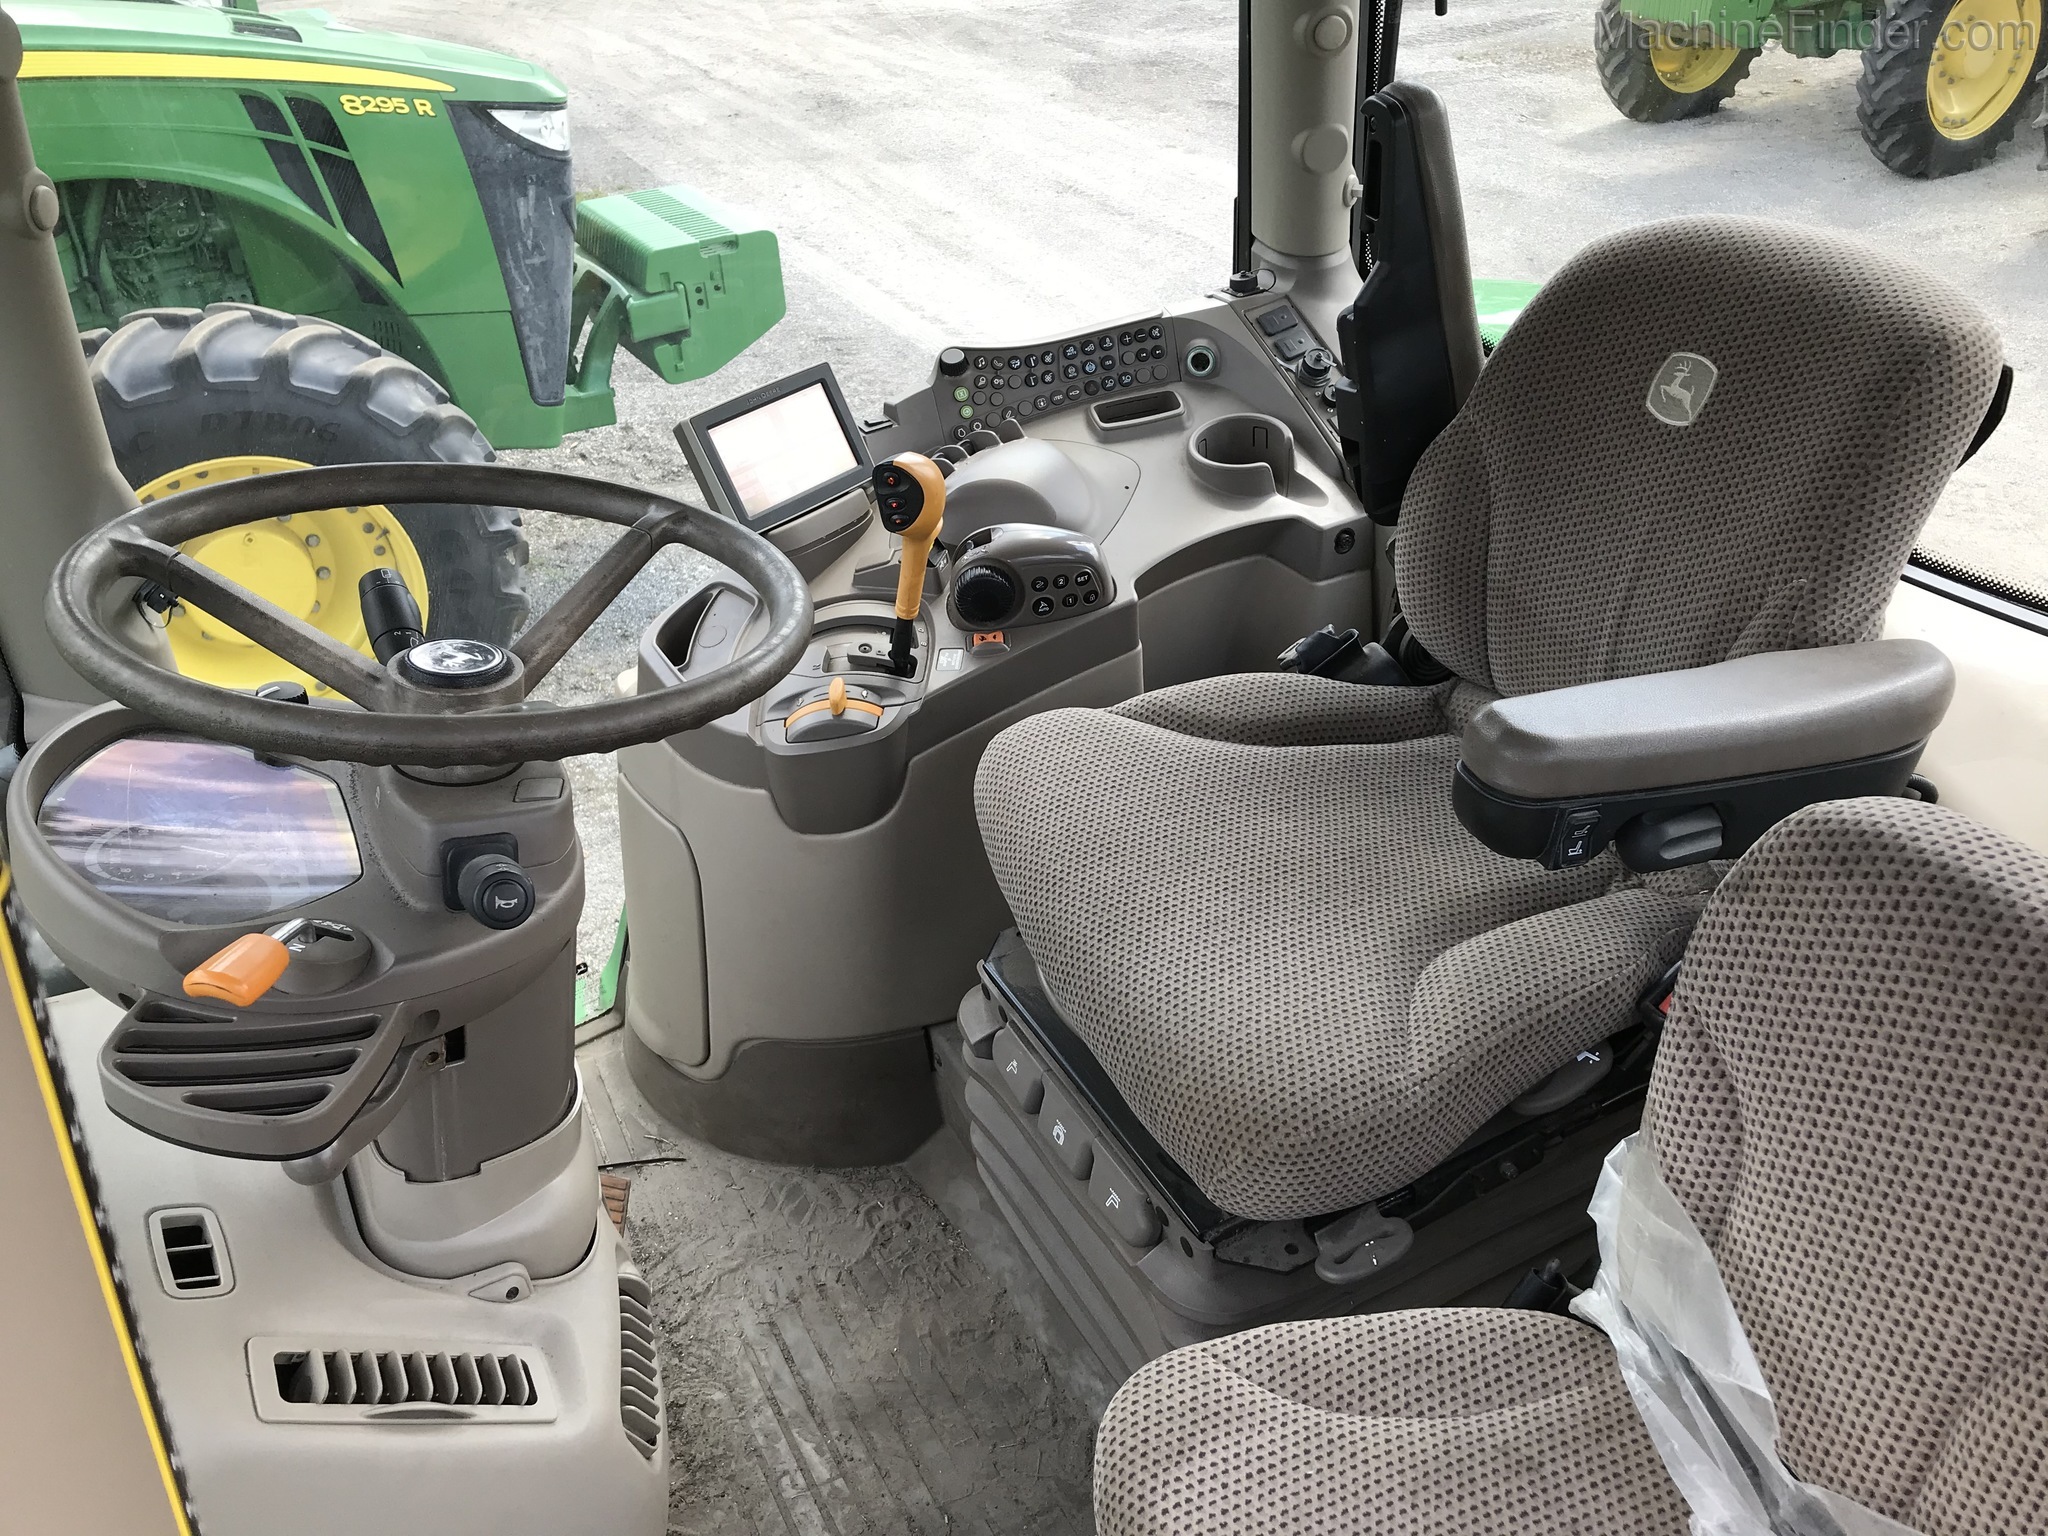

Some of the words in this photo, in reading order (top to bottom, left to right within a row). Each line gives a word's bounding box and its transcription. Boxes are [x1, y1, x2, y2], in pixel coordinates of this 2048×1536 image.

[340, 94, 410, 116] 8295
[413, 98, 436, 117] R
[1077, 575, 1089, 583] SET
